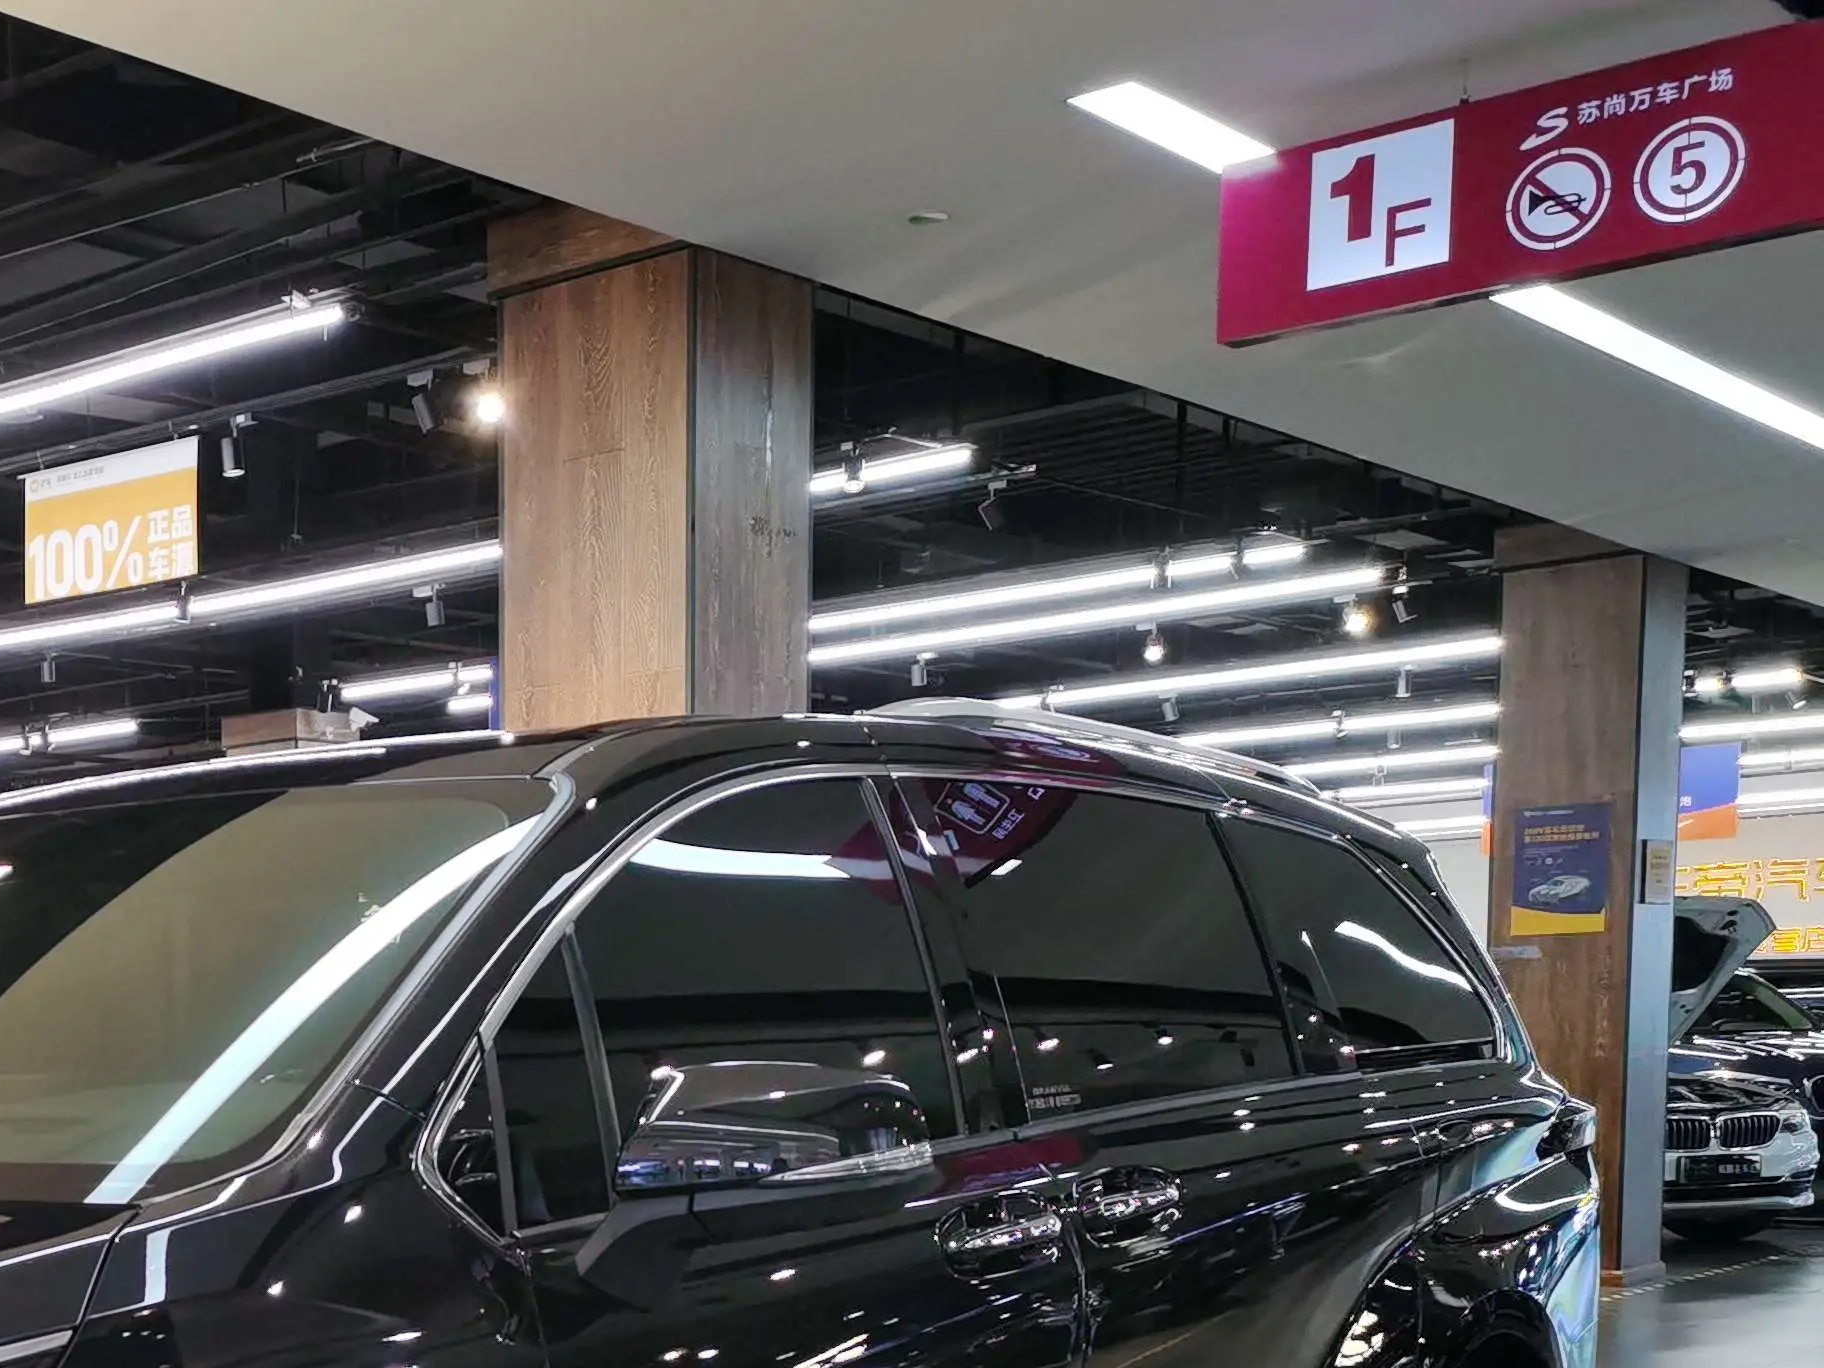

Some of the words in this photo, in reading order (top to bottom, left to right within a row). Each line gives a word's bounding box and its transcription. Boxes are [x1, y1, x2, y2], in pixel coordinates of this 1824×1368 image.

[1577, 67, 1734, 126] 苏尚万车广场
[1670, 138, 1707, 196] 5
[147, 503, 194, 544] 正品
[27, 514, 144, 601] 100%
[147, 541, 195, 582] 车源
